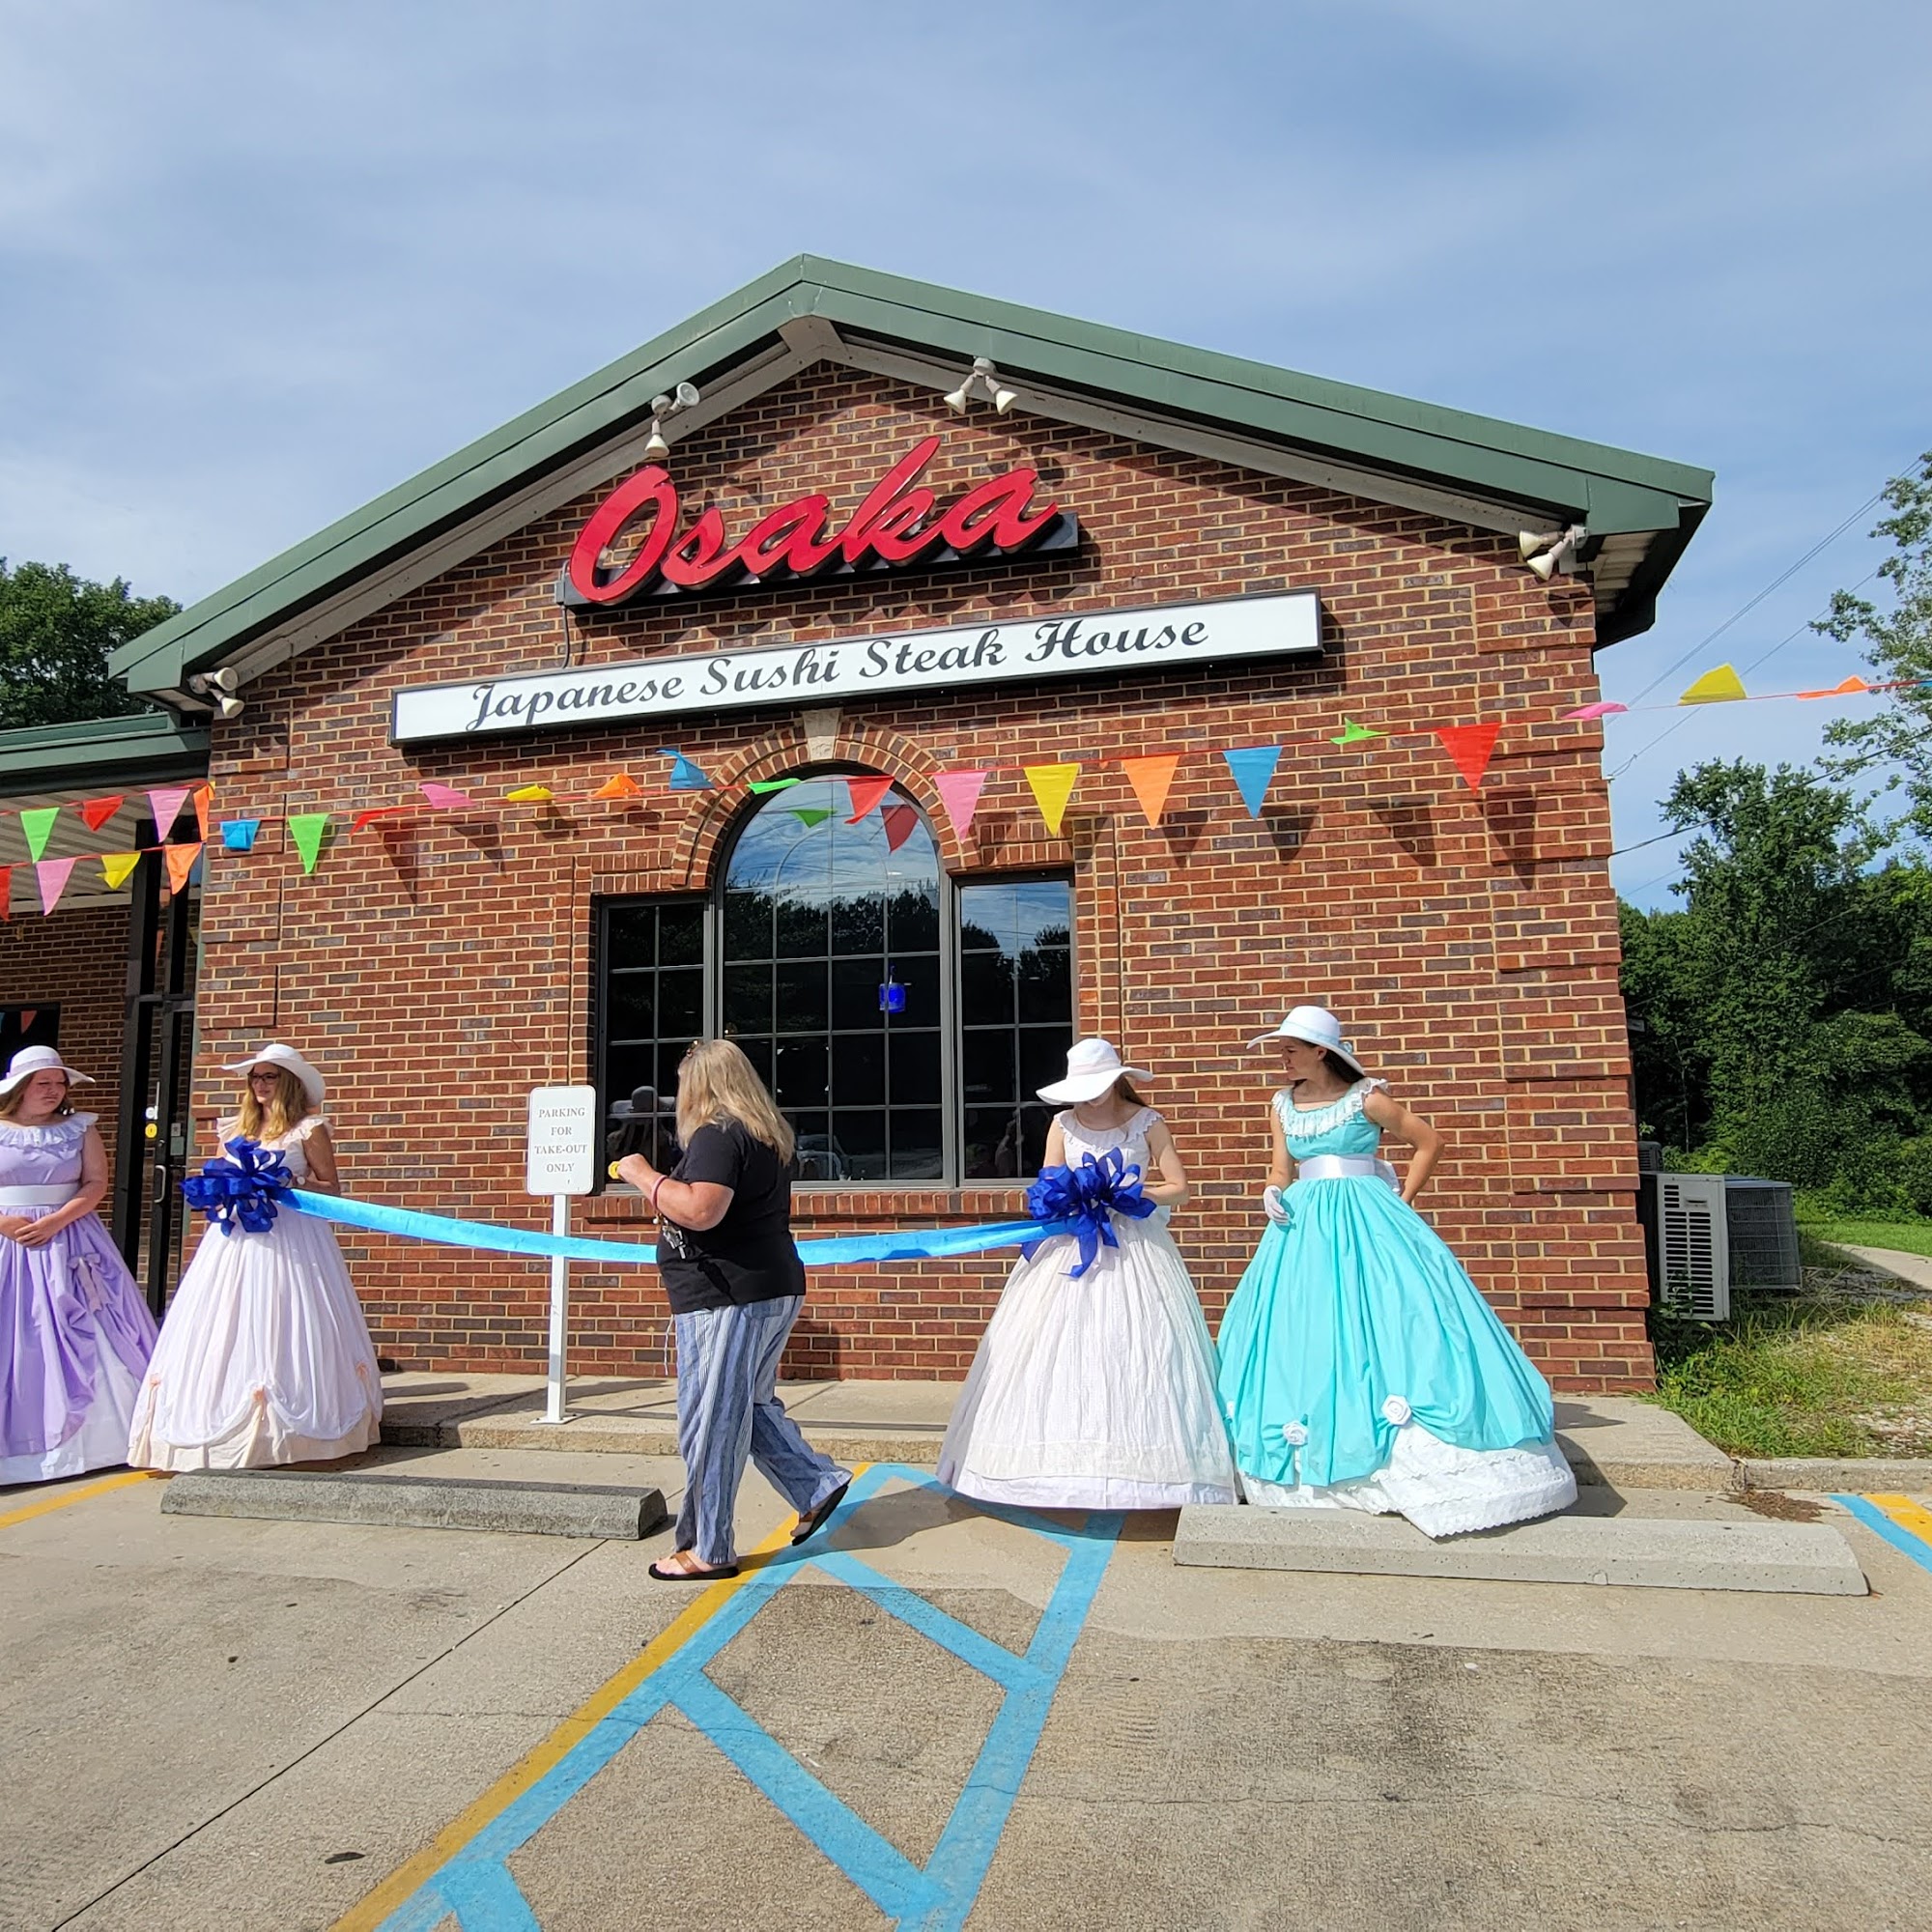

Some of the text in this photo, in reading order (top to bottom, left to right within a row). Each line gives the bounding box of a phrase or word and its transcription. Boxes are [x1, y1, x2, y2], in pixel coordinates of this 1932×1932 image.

[569, 436, 1059, 604] Osaka
[466, 619, 1208, 731] Japanese Sushi Steak House
[539, 1107, 585, 1118] PARKING
[551, 1126, 572, 1136] FOR
[534, 1145, 587, 1154] TAKE-OUT
[546, 1163, 575, 1173] ONLY
